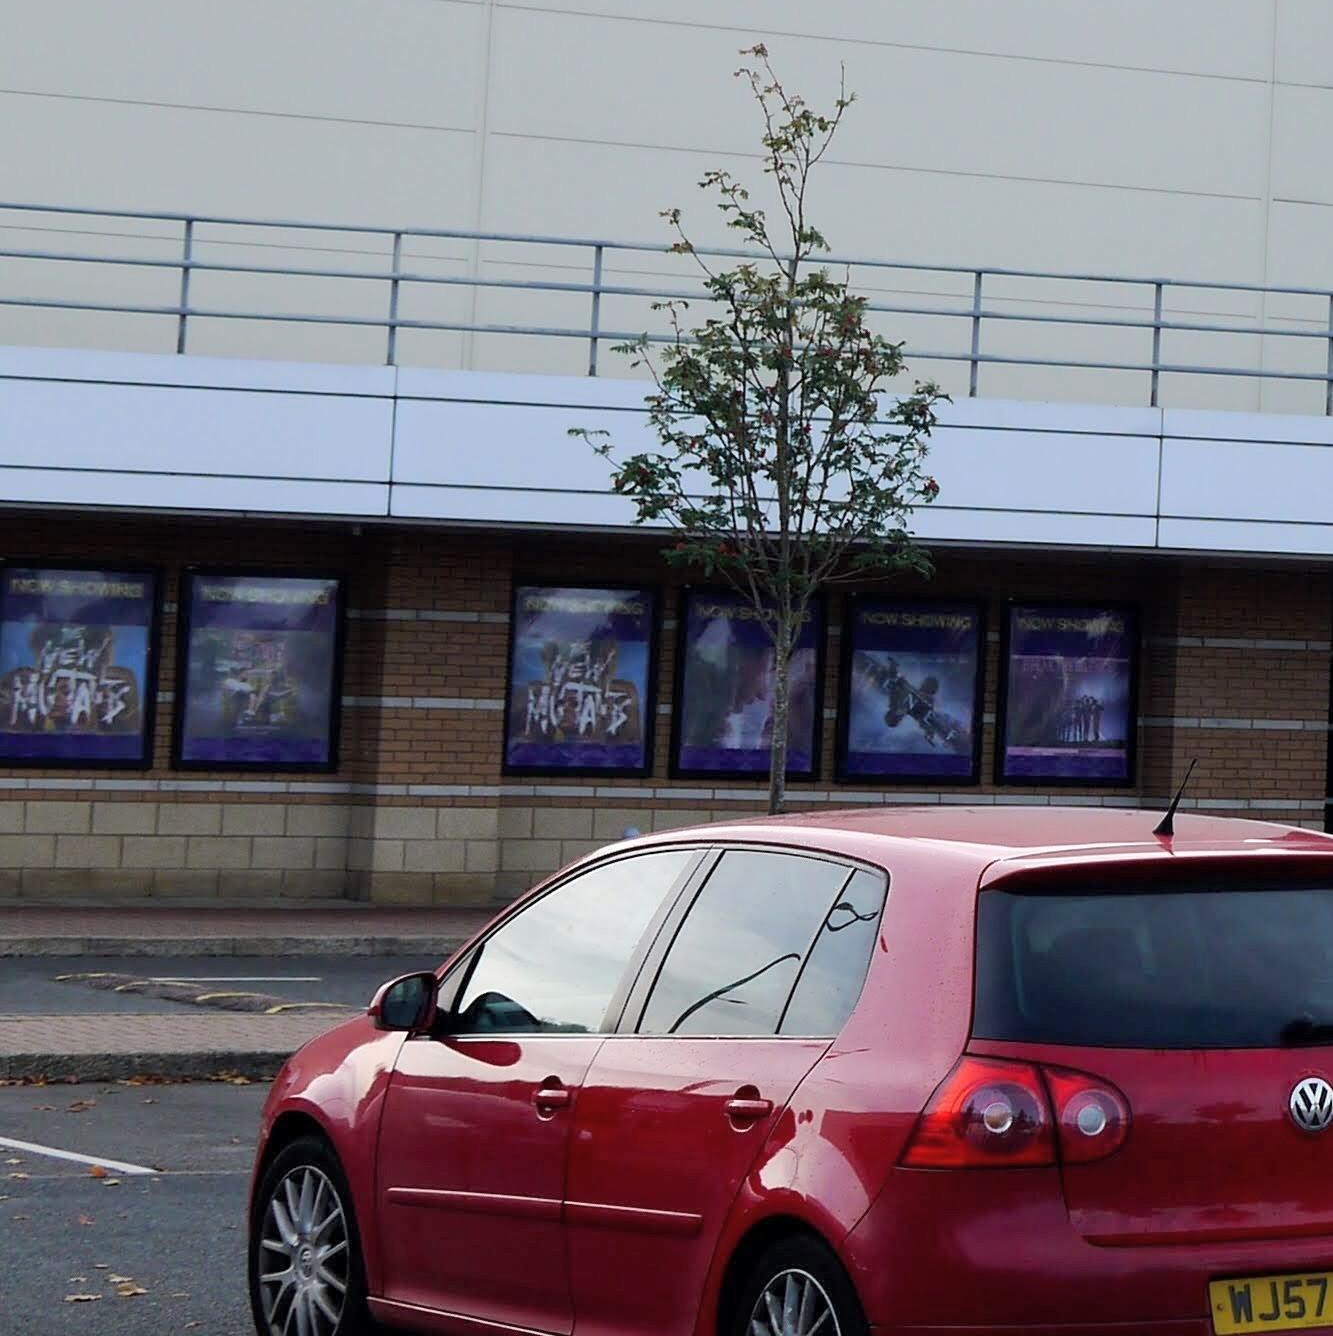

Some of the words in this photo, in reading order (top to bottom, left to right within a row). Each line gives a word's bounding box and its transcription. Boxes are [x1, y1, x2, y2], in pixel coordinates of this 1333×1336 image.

[863, 612, 898, 625] NOW
[901, 614, 972, 631] SHOWING
[1228, 1277, 1328, 1324] WJ57
